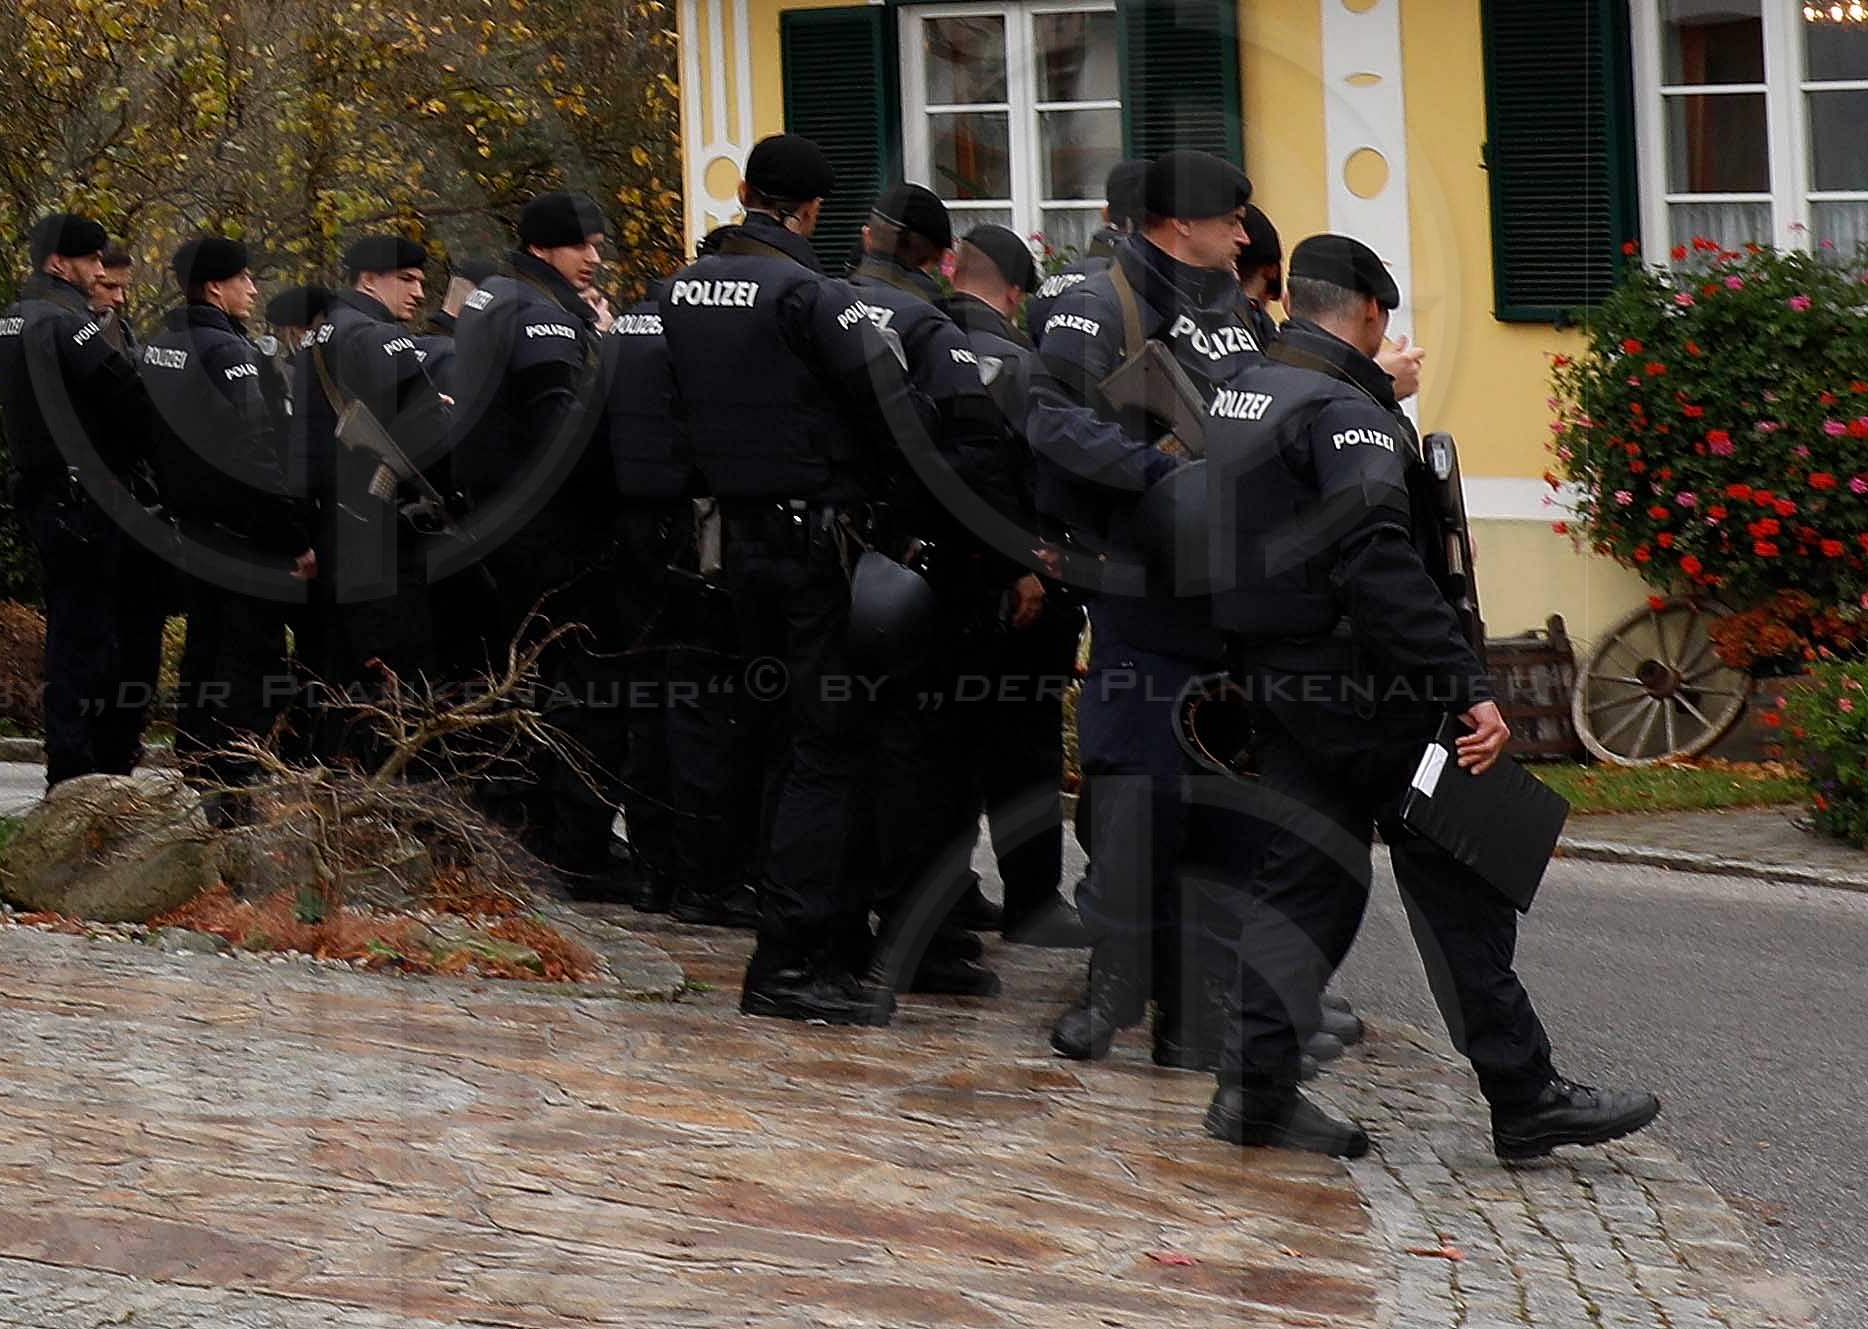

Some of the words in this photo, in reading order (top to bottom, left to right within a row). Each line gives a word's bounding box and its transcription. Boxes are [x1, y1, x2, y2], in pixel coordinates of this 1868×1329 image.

[671, 280, 759, 308] POLIZEI
[836, 299, 867, 331] POLI
[1044, 314, 1100, 337] POLIZEI
[72, 320, 101, 347] POLI
[526, 324, 576, 341] POLIZEI
[1210, 386, 1273, 420] POLIZEI
[1332, 428, 1394, 453] POLIZEI
